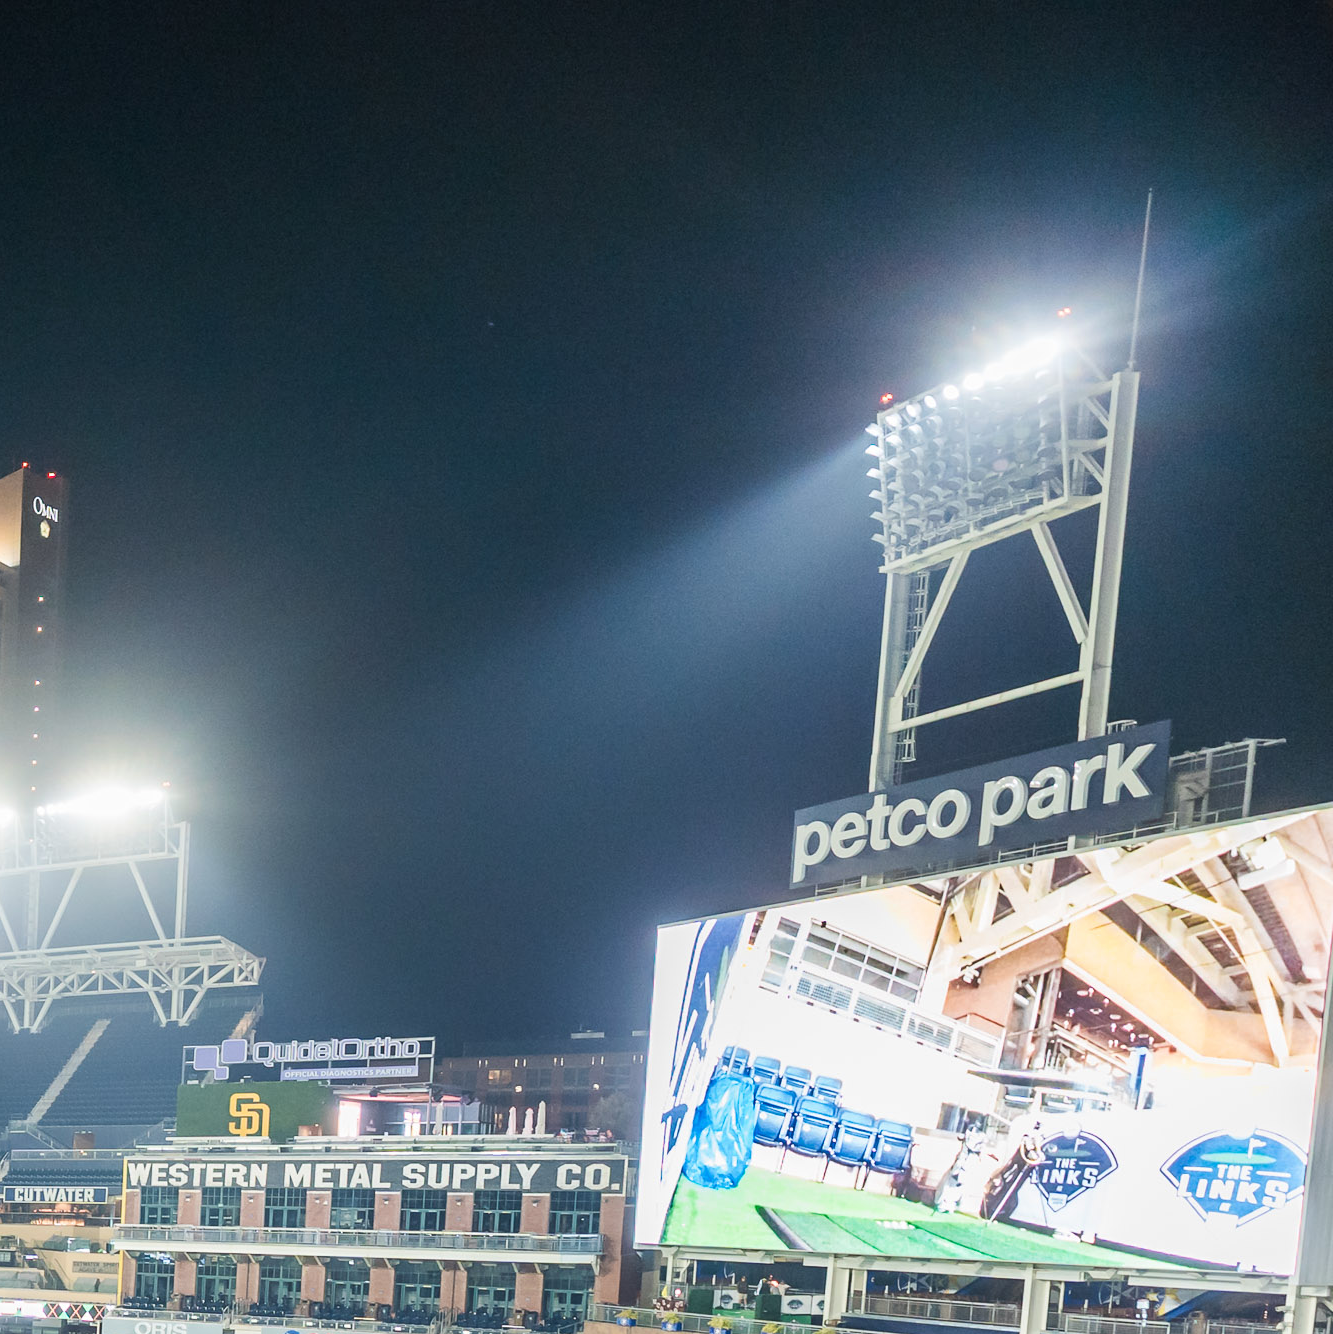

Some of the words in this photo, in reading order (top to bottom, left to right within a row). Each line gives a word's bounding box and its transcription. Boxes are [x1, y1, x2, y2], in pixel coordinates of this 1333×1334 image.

[33, 496, 59, 522] OMNI
[792, 789, 972, 883] petco
[978, 743, 1157, 846] park
[253, 1037, 420, 1067] QuidelOrtho
[284, 1069, 319, 1078] OFFICIAL
[320, 1068, 374, 1077] DIAGNOSTICS
[375, 1067, 412, 1076] PARTNER
[1055, 1157, 1076, 1169] THE
[1217, 1164, 1253, 1181] THE
[128, 1163, 267, 1187] WESTERN
[283, 1163, 392, 1188] METAL
[401, 1163, 540, 1190] SUPPLY
[556, 1163, 620, 1190] CO.
[1031, 1167, 1099, 1188] LINKS
[14, 1188, 95, 1202] CUTWATER
[1177, 1173, 1290, 1209] LINKS
